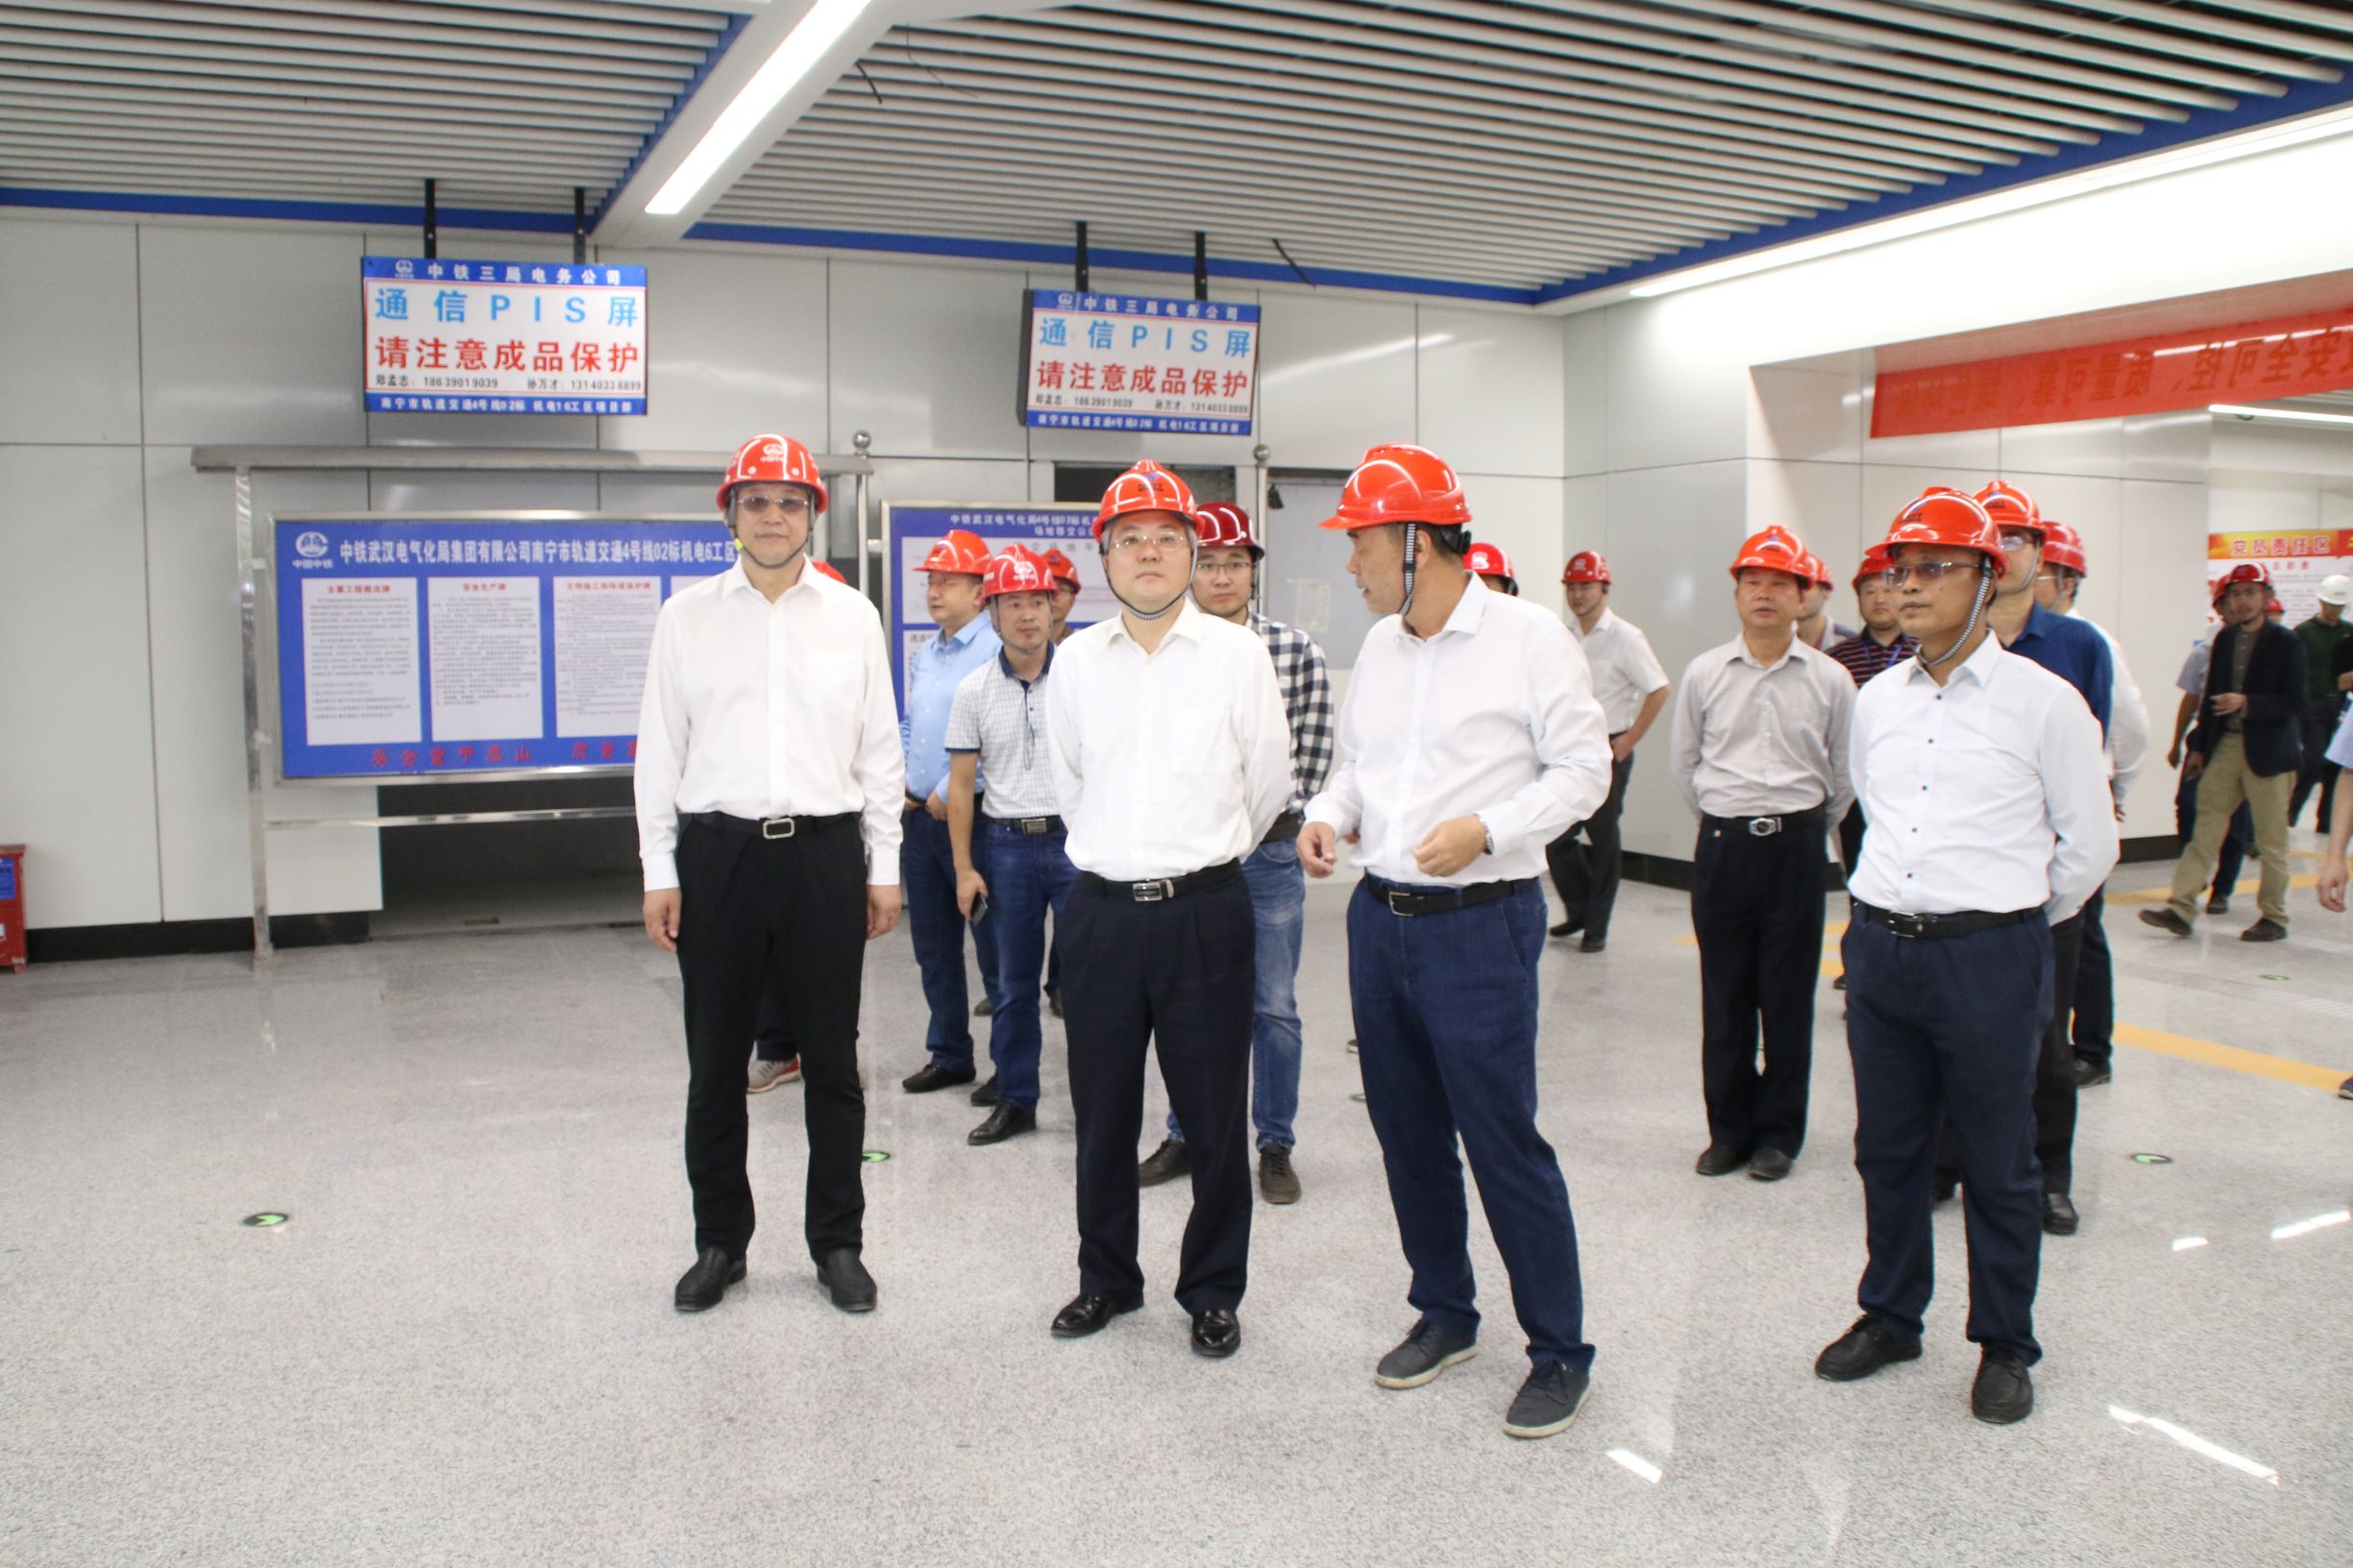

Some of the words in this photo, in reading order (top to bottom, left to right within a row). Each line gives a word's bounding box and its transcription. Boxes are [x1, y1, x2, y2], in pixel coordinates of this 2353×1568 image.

[428, 262, 622, 283] 中铁三局电务公司
[375, 287, 639, 328] 通信PIS屏
[1084, 296, 1239, 321] 中铁三局电务公司
[375, 335, 639, 373] 请注意成品保护
[1039, 317, 1251, 358] 通信PIS屏
[1037, 359, 1248, 398] 请注意成品保护
[2232, 536, 2330, 556] 党员责任区
